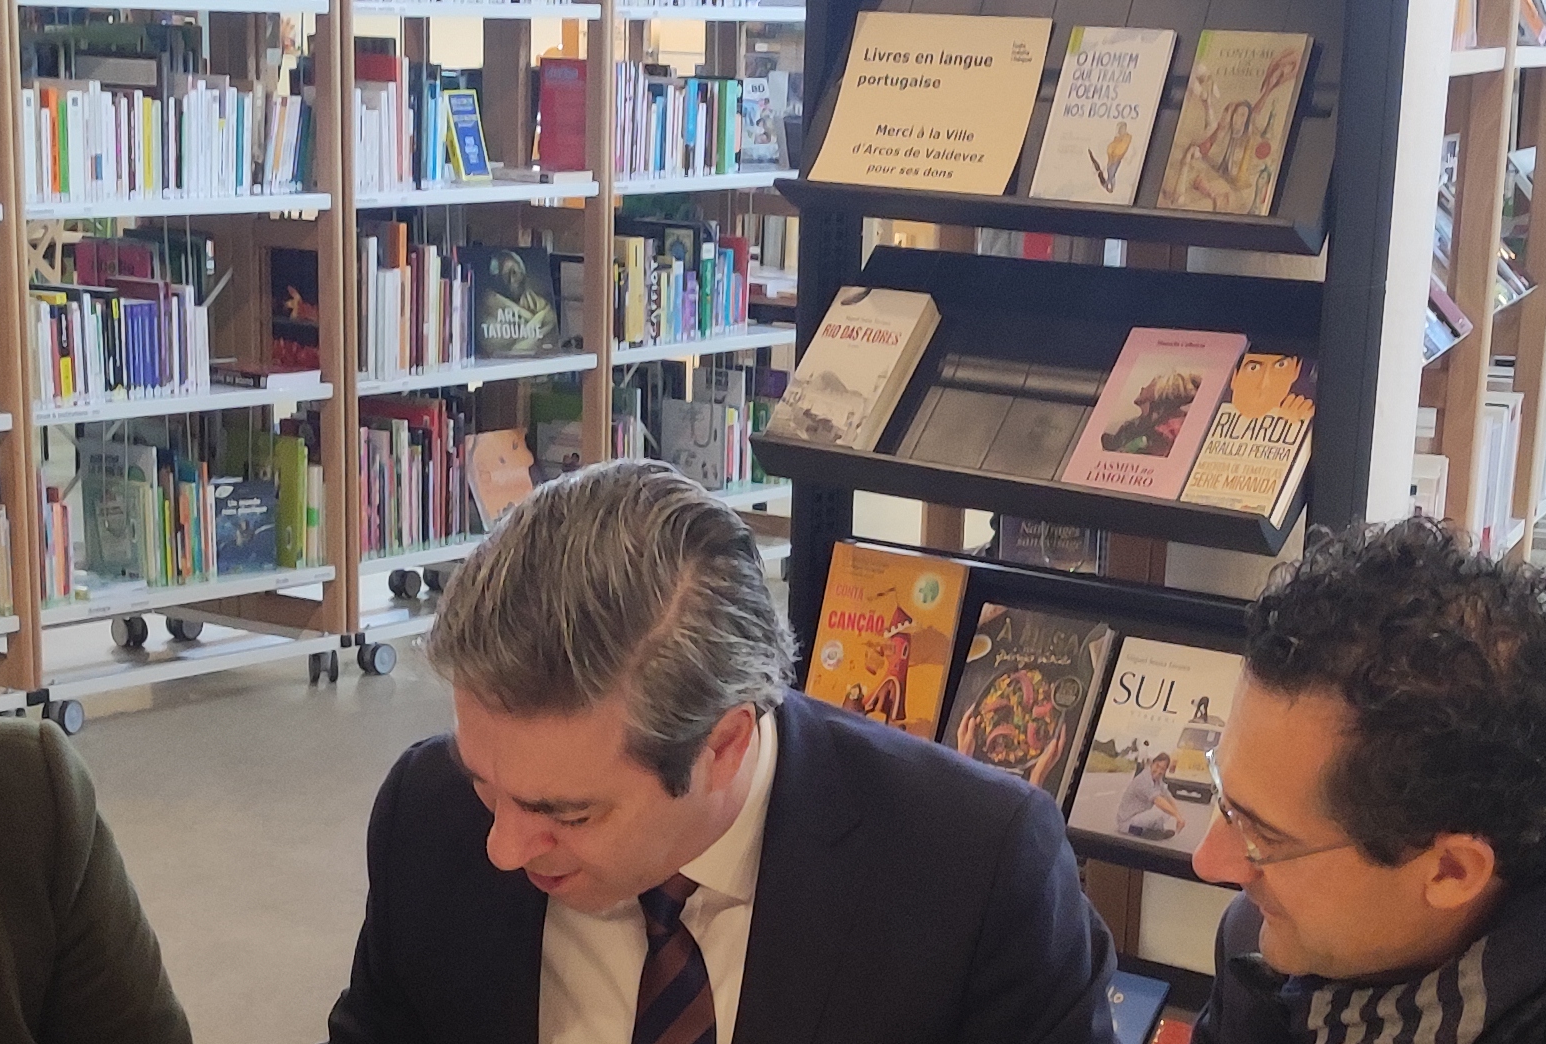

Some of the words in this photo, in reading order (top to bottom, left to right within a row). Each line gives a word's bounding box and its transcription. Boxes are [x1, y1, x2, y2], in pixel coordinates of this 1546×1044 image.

[863, 47, 909, 65] Livres
[915, 53, 934, 65] en
[939, 50, 994, 70] langue
[1076, 51, 1089, 68] O
[1090, 51, 1140, 69] HOMEM
[856, 73, 942, 90] portugaise
[1072, 68, 1093, 83] QUE
[1095, 69, 1133, 84] TRAZIA
[1067, 83, 1120, 101] POEMAS
[1062, 102, 1085, 118] NOS
[1088, 102, 1141, 120] BOLSOS
[875, 124, 914, 138] Merci
[916, 125, 925, 139] à
[928, 127, 941, 140] la
[945, 129, 975, 142] Ville
[852, 143, 900, 157] d'Arcos
[904, 146, 921, 159] de
[925, 148, 986, 163] Valdevez
[866, 163, 896, 175] pour
[899, 166, 919, 176] ses
[923, 167, 954, 179] dons
[497, 308, 519, 322] ART
[481, 322, 544, 340] TATOUAGE
[821, 323, 842, 338] RIO
[840, 325, 863, 341] DAS
[861, 328, 901, 346] FLORES
[1211, 412, 1305, 446] RICARDO
[1249, 445, 1292, 462] PEREIRA
[1085, 471, 1154, 489] LIMOEIRO
[1222, 474, 1277, 495] MIRANDA
[835, 583, 864, 600] CONTA
[827, 608, 885, 636] CANÇÃO
[1113, 670, 1178, 715] SUL
